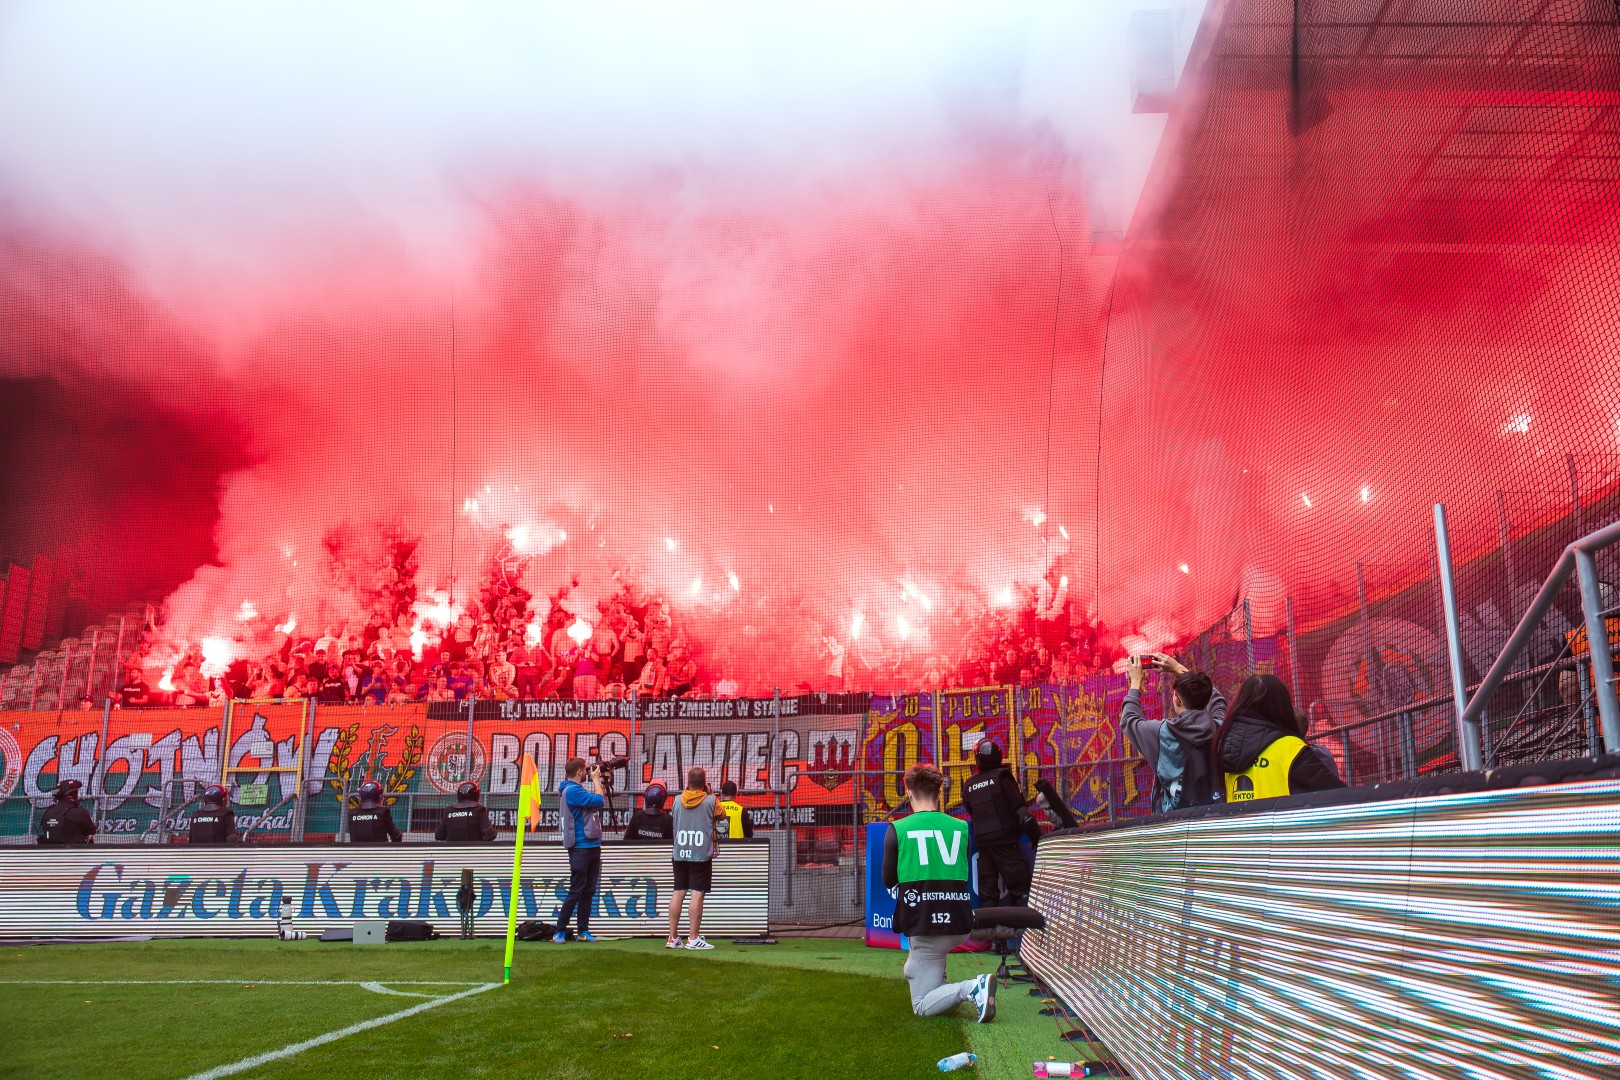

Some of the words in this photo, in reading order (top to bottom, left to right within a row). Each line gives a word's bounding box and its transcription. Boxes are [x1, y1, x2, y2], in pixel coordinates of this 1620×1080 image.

[525, 701, 585, 718] TRADYCJI
[587, 701, 616, 718] NIKT
[645, 702, 676, 718] JEST
[737, 701, 749, 716] W
[754, 698, 798, 716] STANIE
[488, 729, 801, 795] BOLESŁAWIEC
[234, 807, 294, 831] arka!
[676, 830, 704, 847] OTO
[906, 829, 962, 866] TV
[679, 849, 692, 858] 012
[76, 861, 283, 920] Gazeta
[931, 912, 951, 924] 152
